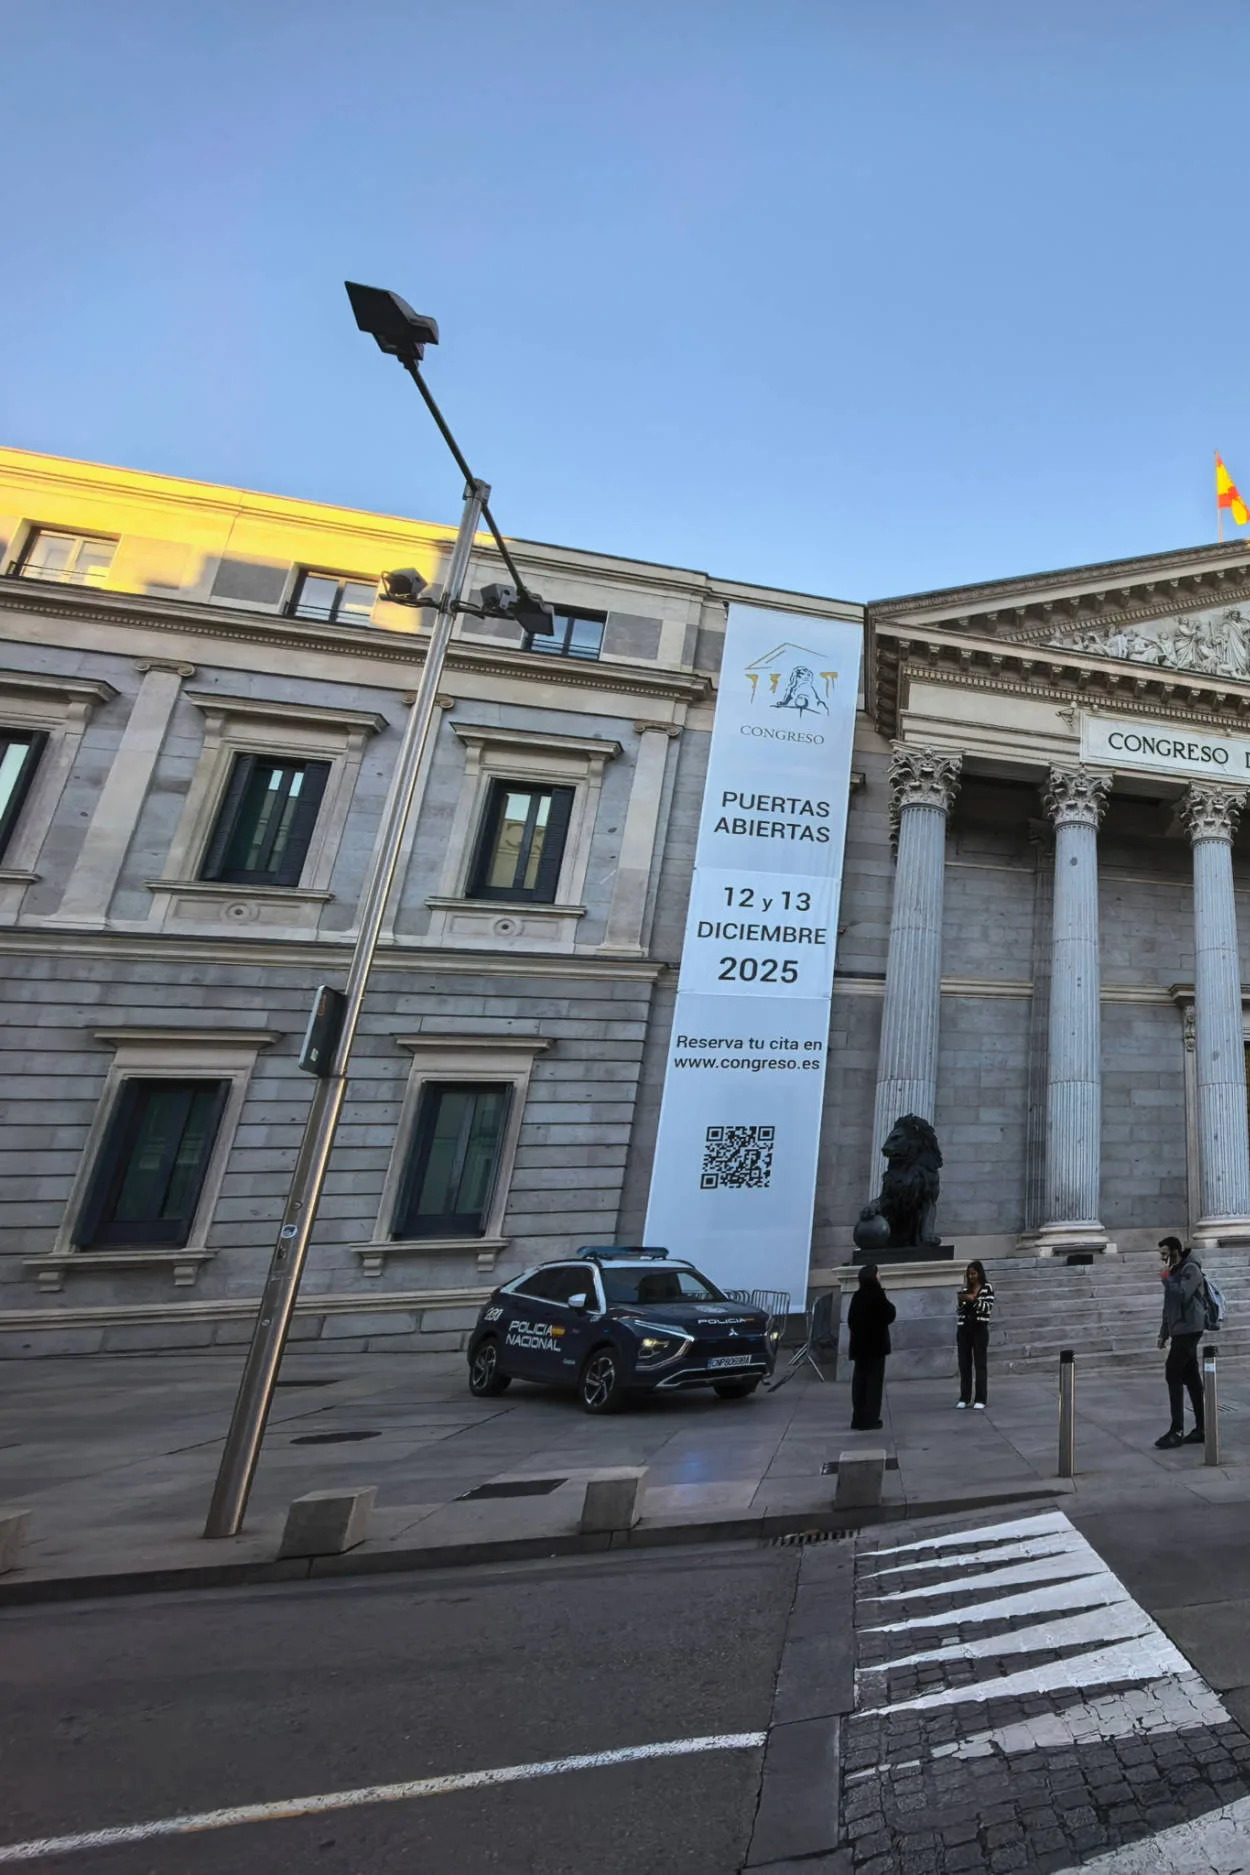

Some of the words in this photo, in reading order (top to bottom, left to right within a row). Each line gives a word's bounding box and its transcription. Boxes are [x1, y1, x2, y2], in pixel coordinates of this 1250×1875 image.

[740, 725, 825, 745] CONGRESO
[1108, 732, 1229, 765] CONGRESO
[722, 791, 831, 818] PUERTAS
[714, 817, 831, 843] ABIERTAS
[724, 886, 755, 908] 12
[762, 898, 774, 912] y
[781, 890, 811, 912] 13
[697, 921, 827, 945] DICIEMBRE
[718, 956, 799, 984] 2025
[676, 1035, 743, 1049] Reserva
[749, 1037, 765, 1050] tu
[769, 1036, 799, 1051] cita
[804, 1040, 823, 1051] en
[674, 1057, 821, 1072] www.congreso.es
[505, 1333, 562, 1352] NACIONAL
